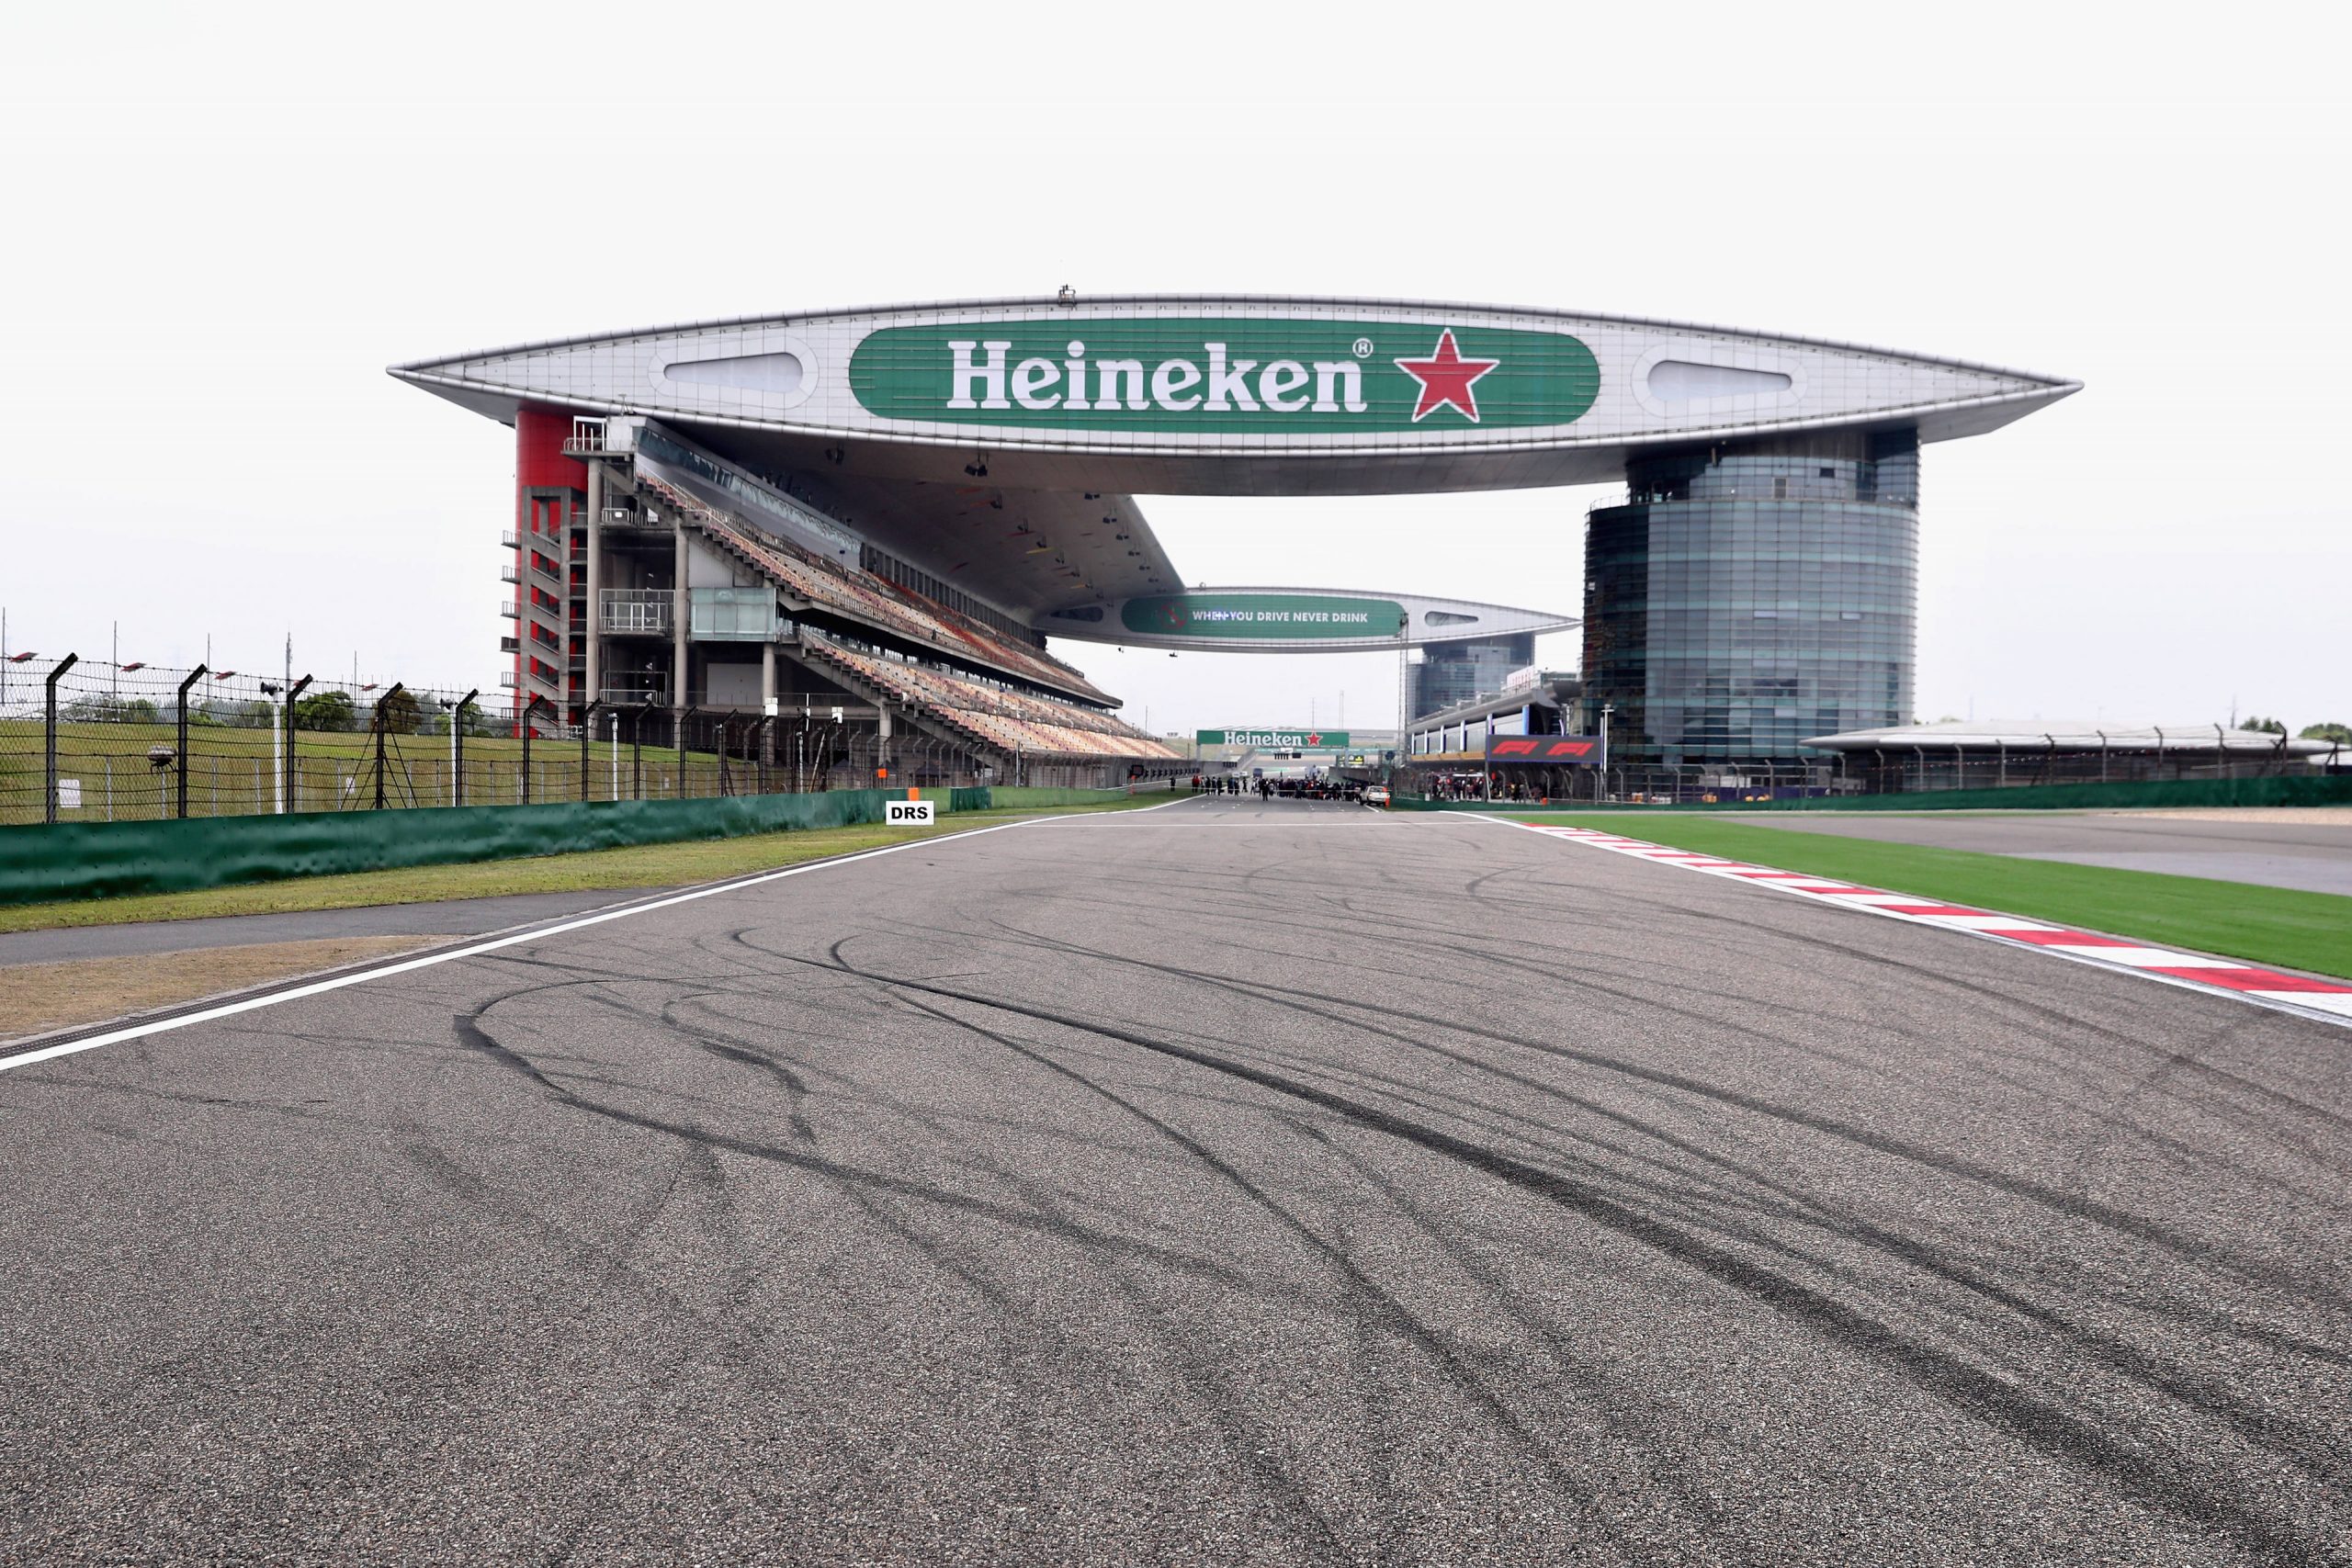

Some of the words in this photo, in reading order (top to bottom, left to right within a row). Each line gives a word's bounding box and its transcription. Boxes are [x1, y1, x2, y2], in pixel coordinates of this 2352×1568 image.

[946, 340, 1368, 412] Heineken
[1193, 611, 1227, 622] WHEN
[1230, 611, 1254, 622] YOU
[1257, 611, 1290, 622] DRIVE
[1293, 612, 1329, 623] NEVER
[1331, 613, 1368, 623] DRINK
[1224, 731, 1303, 746] Heineken
[891, 807, 928, 819] DRS
